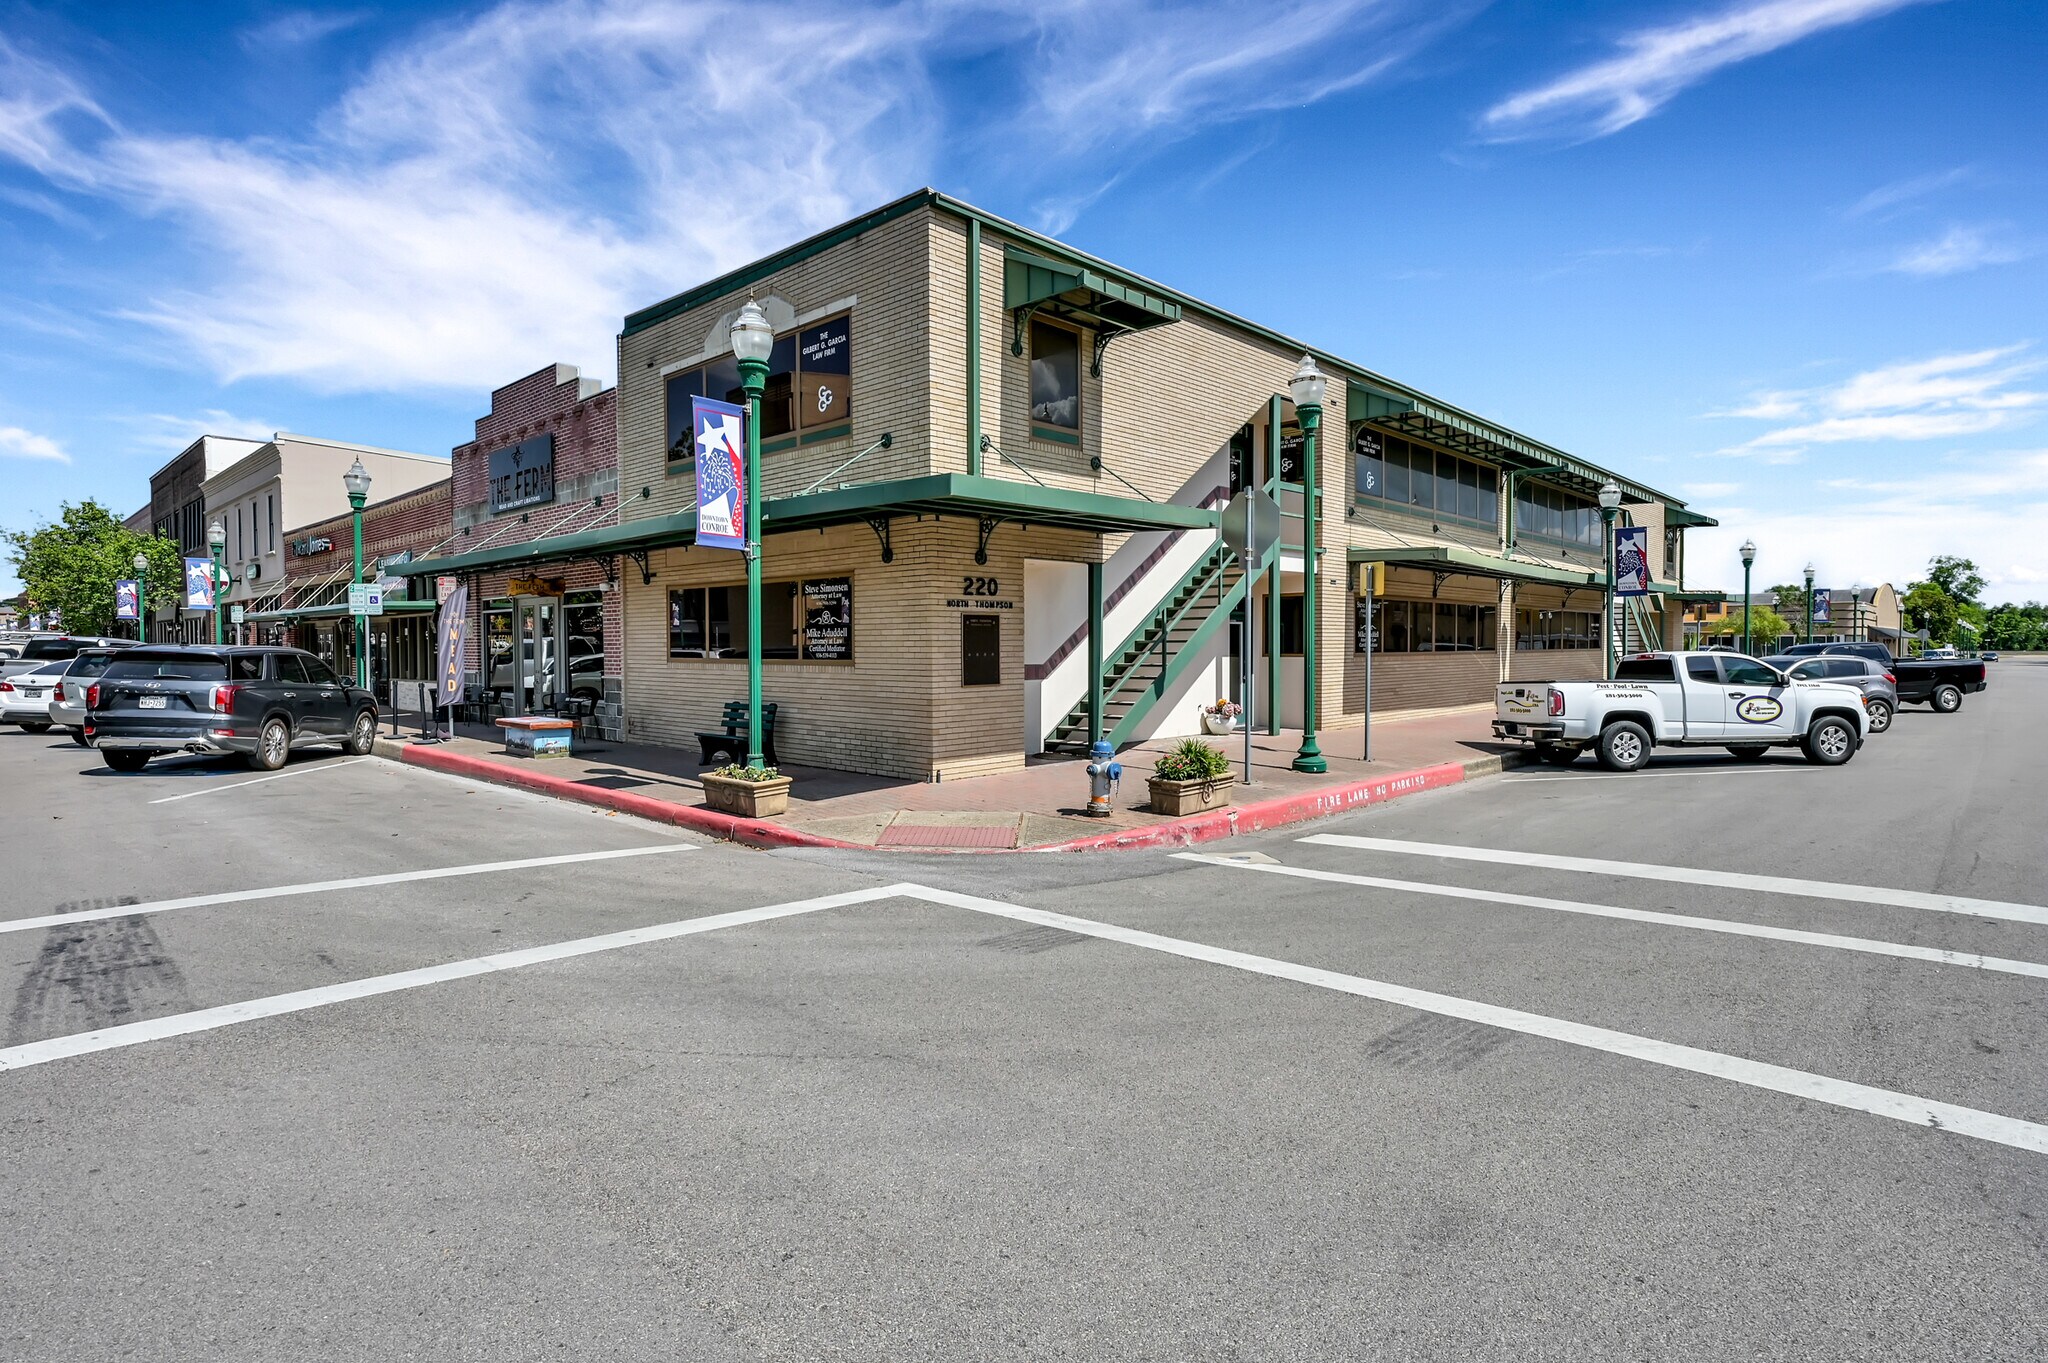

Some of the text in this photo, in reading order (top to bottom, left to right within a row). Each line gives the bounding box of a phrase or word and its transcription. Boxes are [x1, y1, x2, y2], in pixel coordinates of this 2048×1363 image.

[820, 332, 828, 340] THE
[803, 343, 820, 355] GILBERT
[828, 334, 846, 346] GARCIA
[812, 347, 836, 361] LAW FIRM
[490, 462, 550, 505] THE FERM
[524, 495, 540, 505] LIBATIONS
[702, 514, 728, 523] DOWNTOWN
[702, 522, 728, 533] CONROE
[805, 584, 848, 593] Steve Simonsen
[963, 576, 998, 596] 220
[975, 600, 1013, 609] THOMPSON
[806, 628, 847, 637] Mike Aduddell
[447, 628, 458, 692] MEAD
[1317, 775, 1425, 809] FIRE LANE NO PARKING
